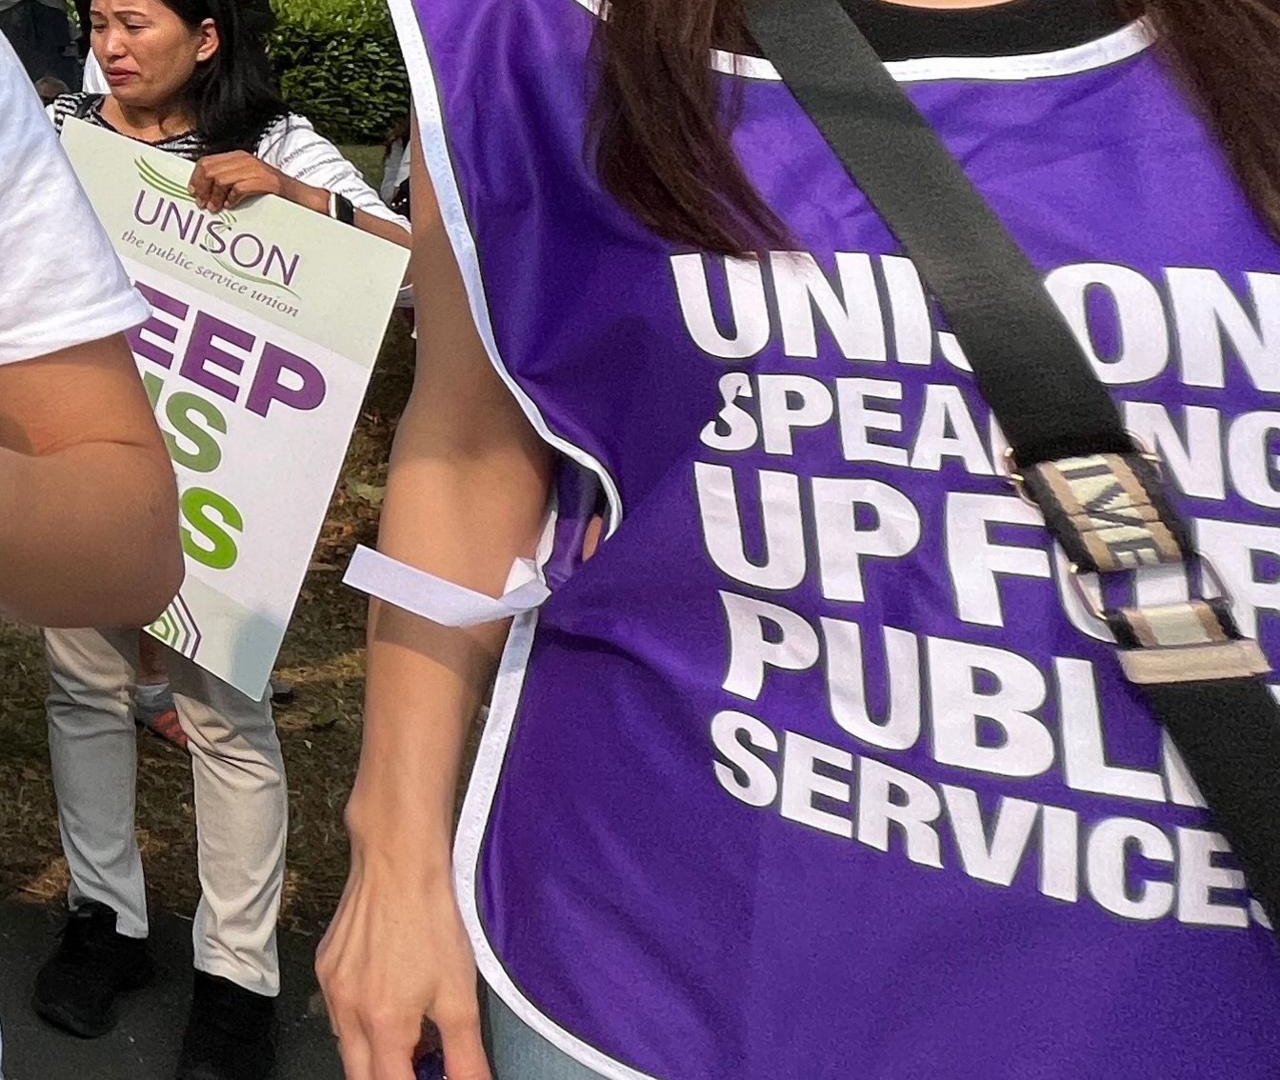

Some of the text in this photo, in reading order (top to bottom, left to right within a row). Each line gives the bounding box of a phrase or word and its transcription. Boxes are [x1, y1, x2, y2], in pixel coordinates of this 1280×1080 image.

[121, 229, 300, 318] the public service union
[133, 189, 300, 287] UNISON
[123, 280, 327, 419] EEP
[670, 250, 1280, 393] UNION
[140, 370, 227, 474] S
[699, 372, 1280, 508] SPEANG
[693, 460, 921, 603] UP
[709, 709, 1273, 931] SERVICE
